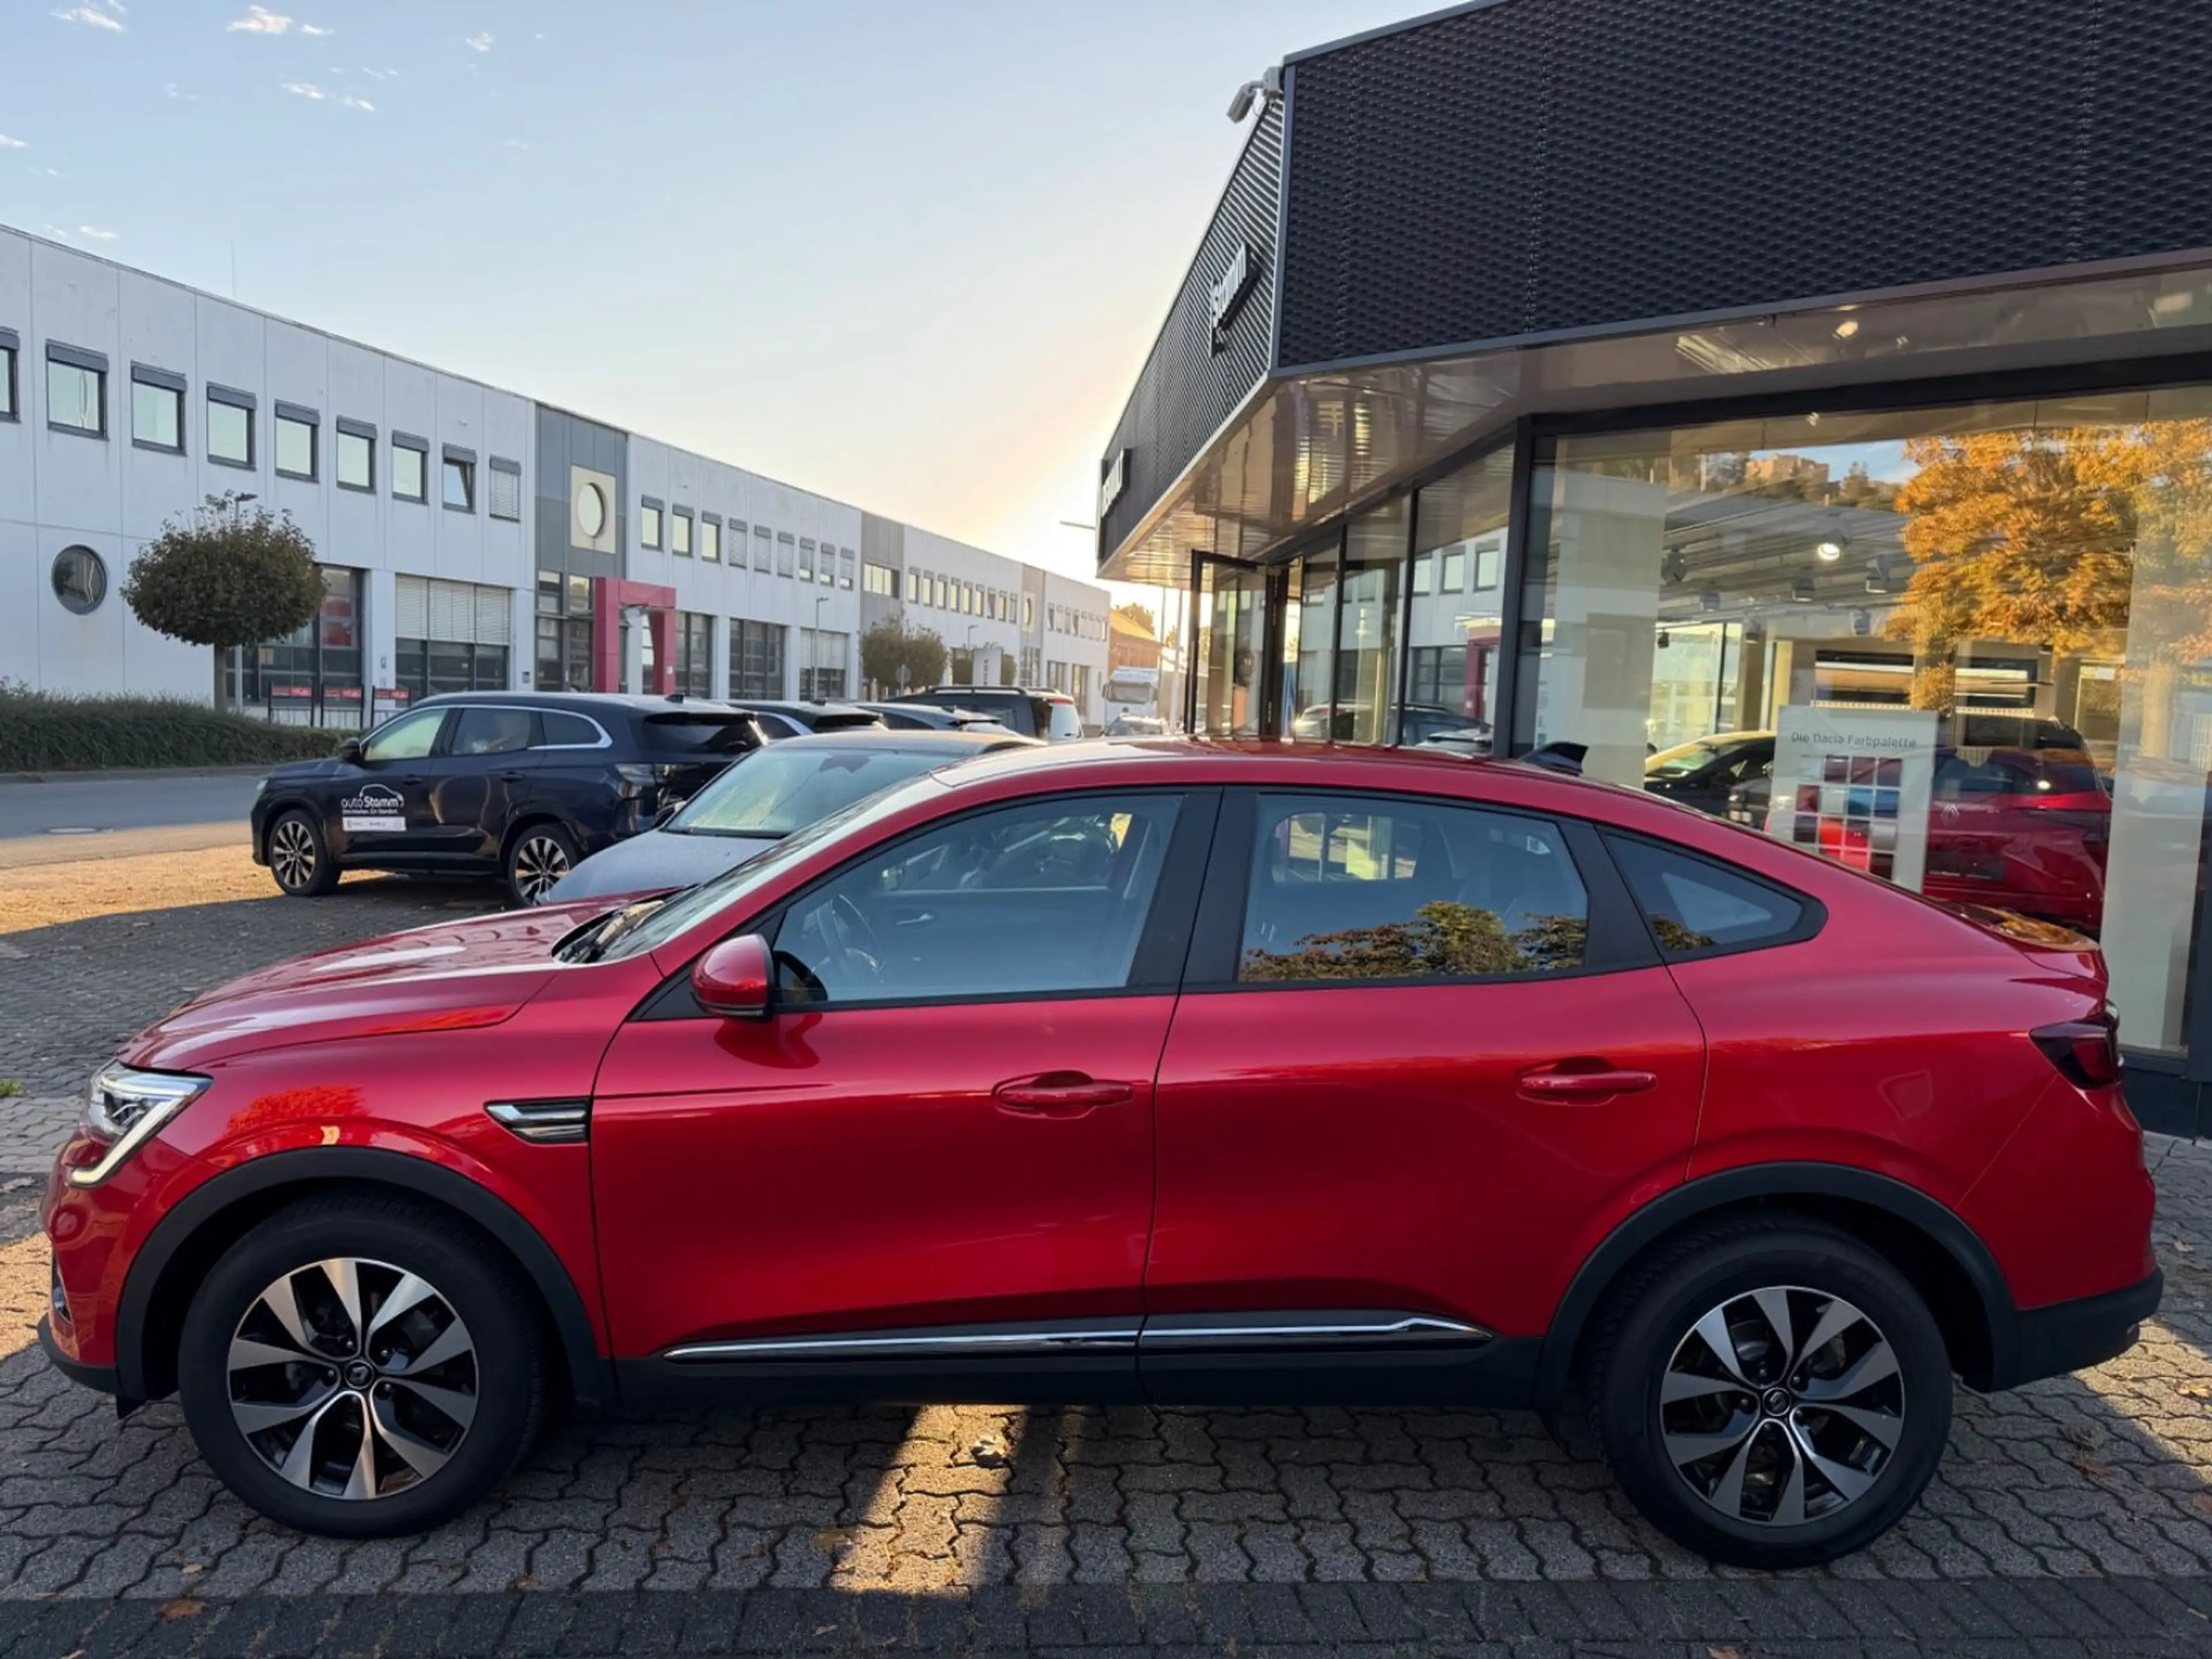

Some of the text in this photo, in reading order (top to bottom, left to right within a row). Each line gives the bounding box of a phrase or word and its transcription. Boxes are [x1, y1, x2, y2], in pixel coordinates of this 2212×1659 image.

[1791, 732, 1916, 748] Die Dacia Farbpalette
